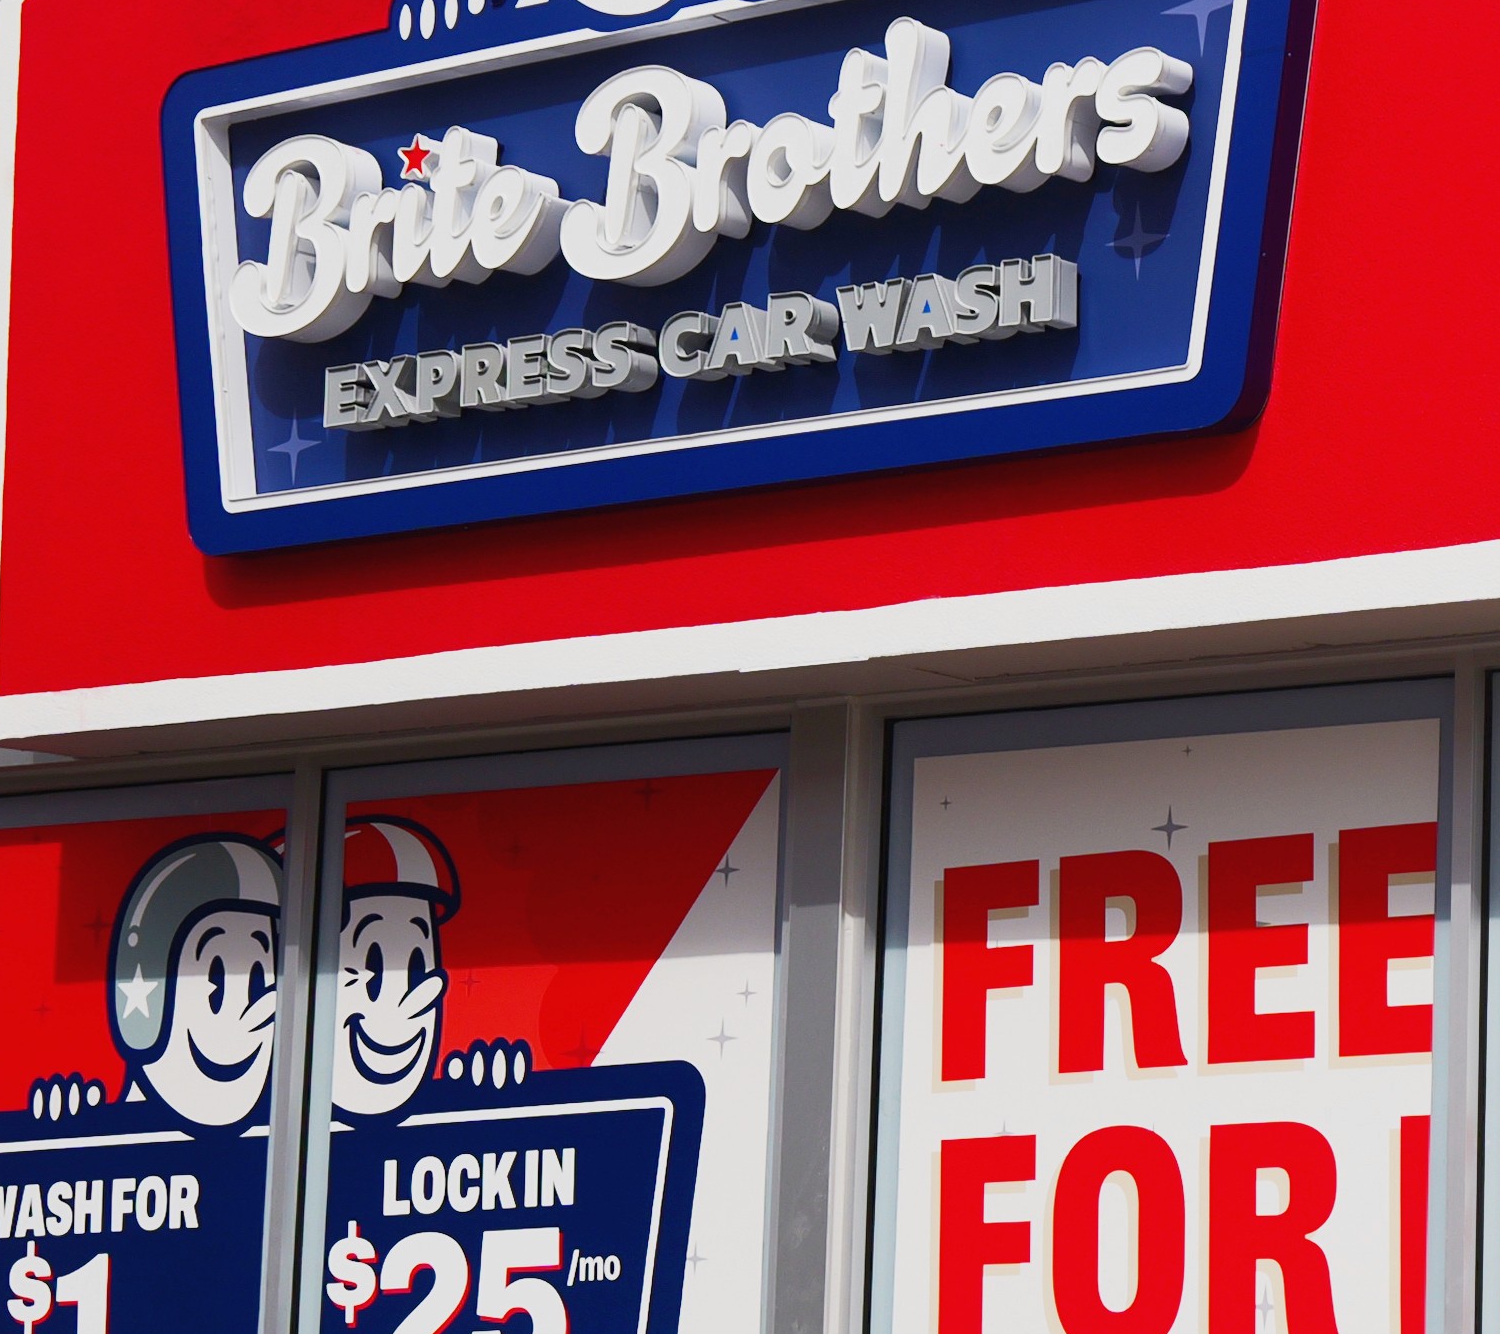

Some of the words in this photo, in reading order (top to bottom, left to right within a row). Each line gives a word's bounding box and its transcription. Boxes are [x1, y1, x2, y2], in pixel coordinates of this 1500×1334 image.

[230, 127, 558, 341] Brite
[561, 18, 1193, 286] Brothers
[323, 322, 658, 432] EXPRESS
[660, 292, 839, 382] CAR
[836, 254, 1078, 355] WASH
[940, 821, 1437, 1082] FREE
[110, 1175, 200, 1233] FOR
[383, 1152, 517, 1217] LOCK
[524, 1148, 576, 1208] IN
